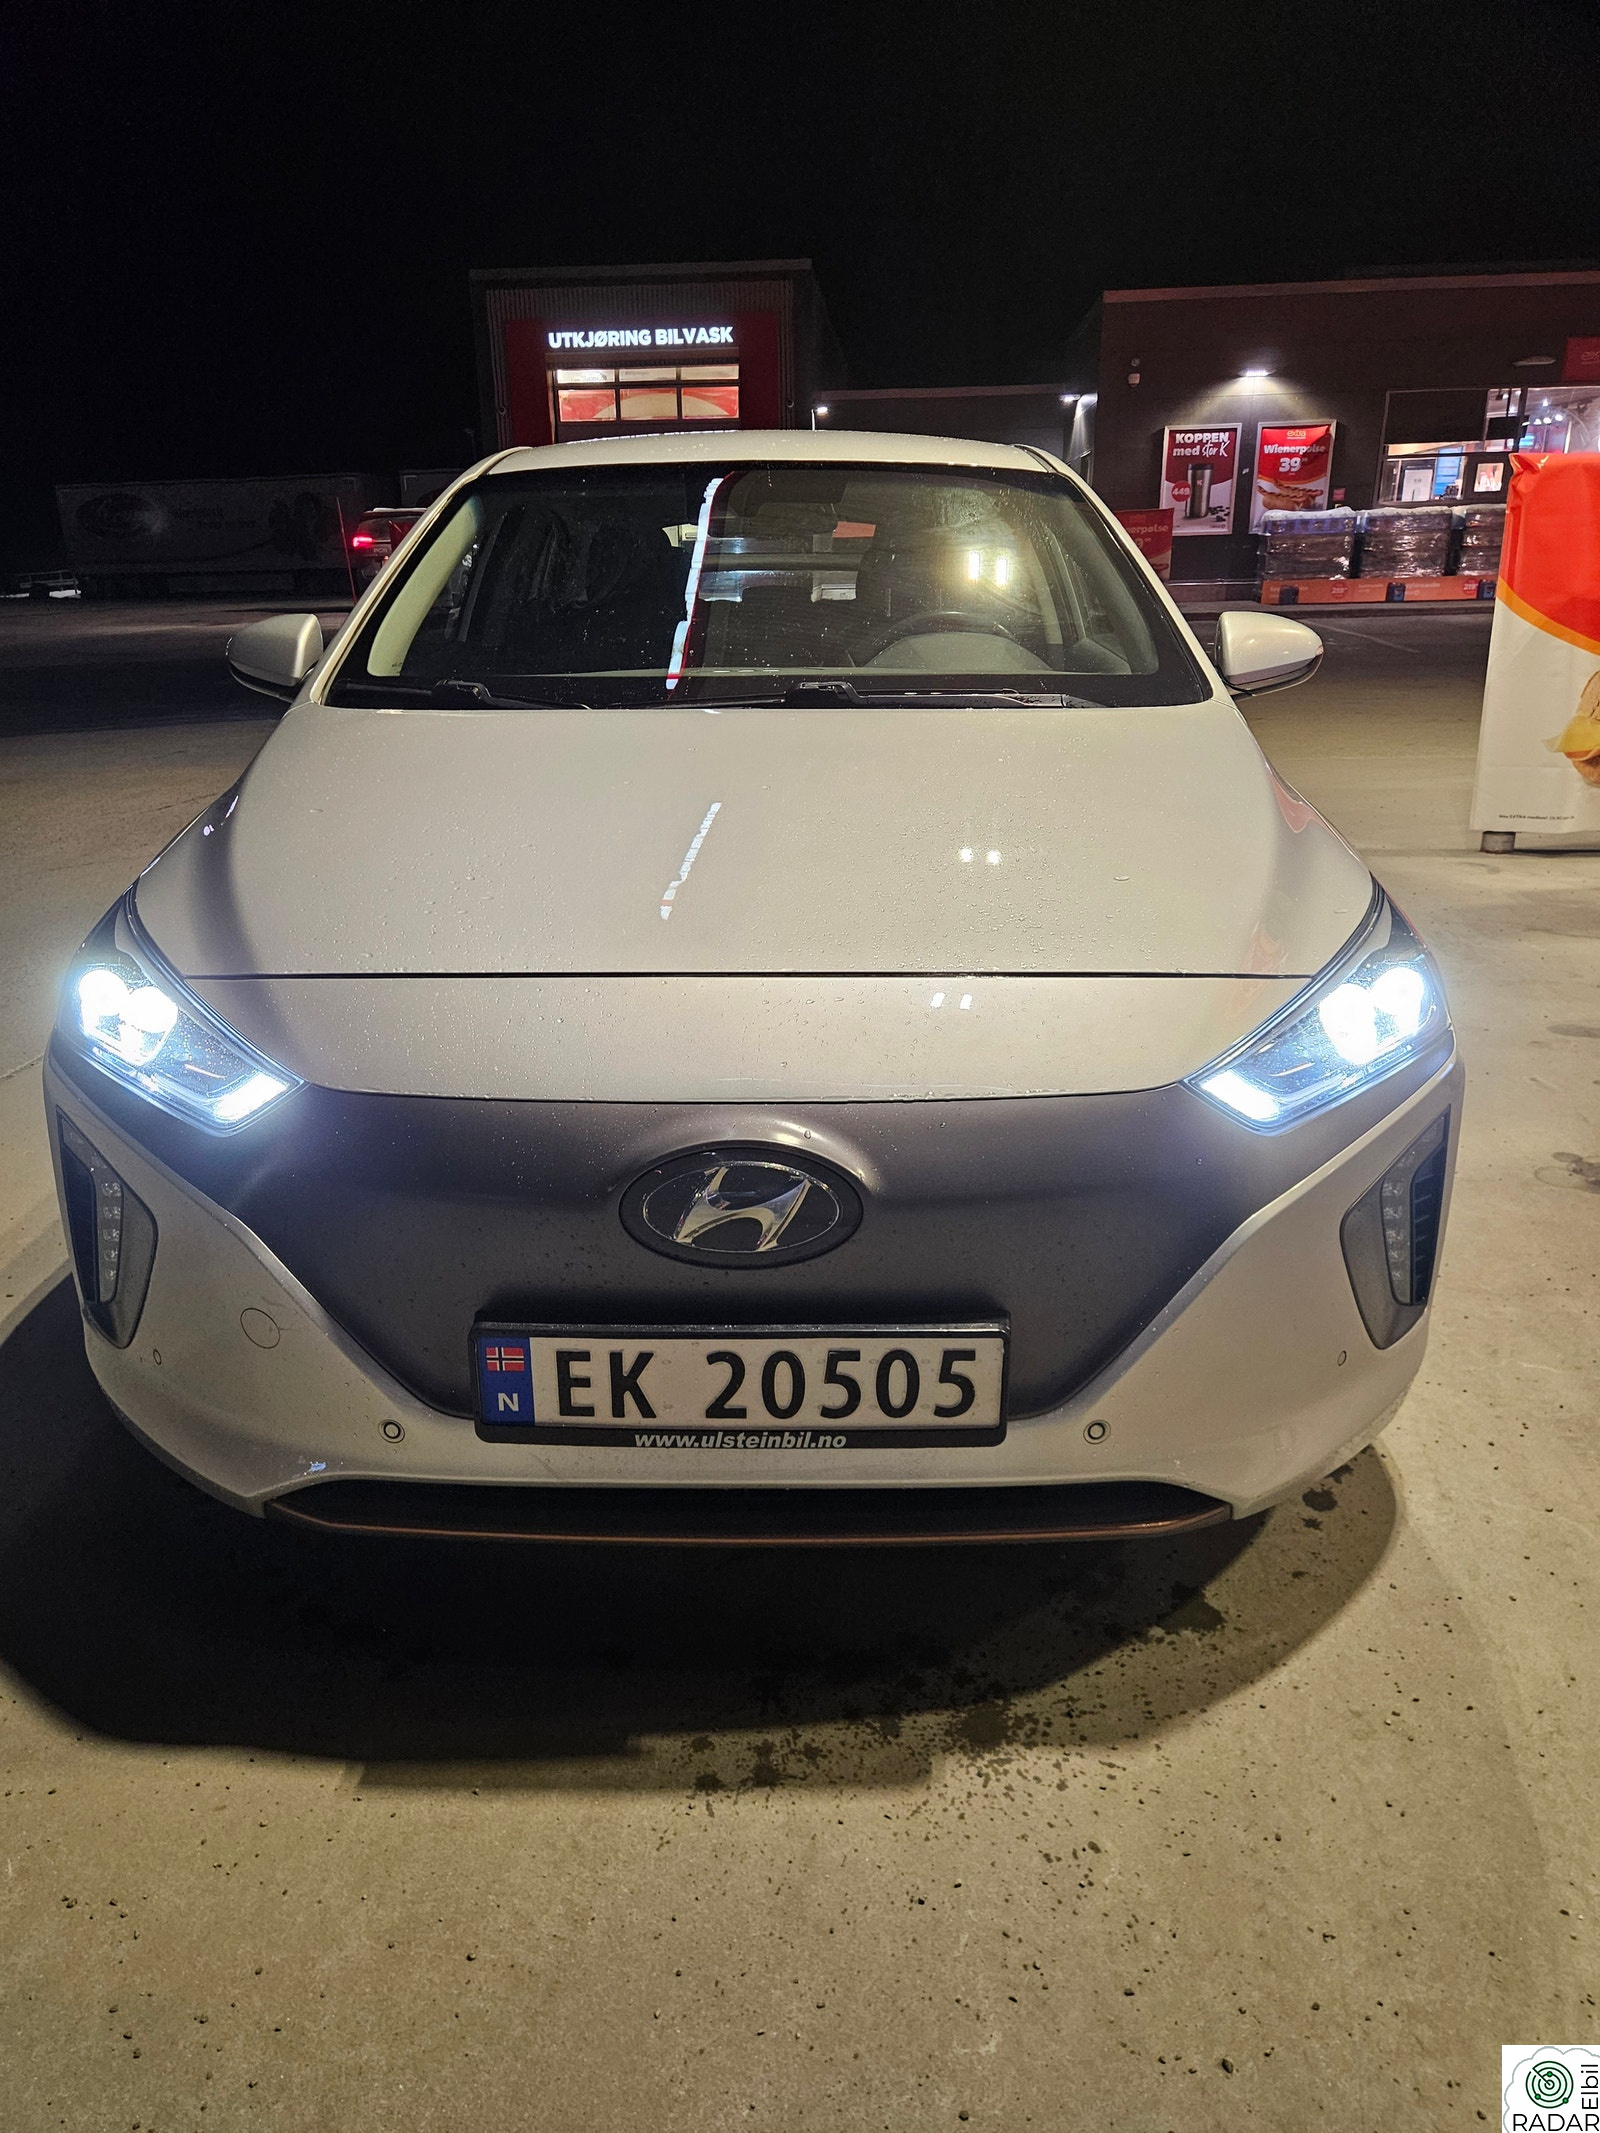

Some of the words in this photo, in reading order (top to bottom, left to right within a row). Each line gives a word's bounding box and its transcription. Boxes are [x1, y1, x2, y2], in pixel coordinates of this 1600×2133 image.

[548, 329, 651, 349] UTKJØRING
[655, 326, 734, 346] BILVASK
[1175, 432, 1229, 444] KOPPEN
[1172, 445, 1200, 456] med
[1201, 440, 1218, 457] stor
[1219, 440, 1230, 457] K
[1263, 443, 1326, 455] Wienerpølse
[1172, 487, 1191, 496] 449
[555, 1349, 658, 1420] EK
[703, 1348, 978, 1420] 20505
[497, 1391, 520, 1413] N
[634, 1431, 847, 1450] www.ulsteinbil.no
